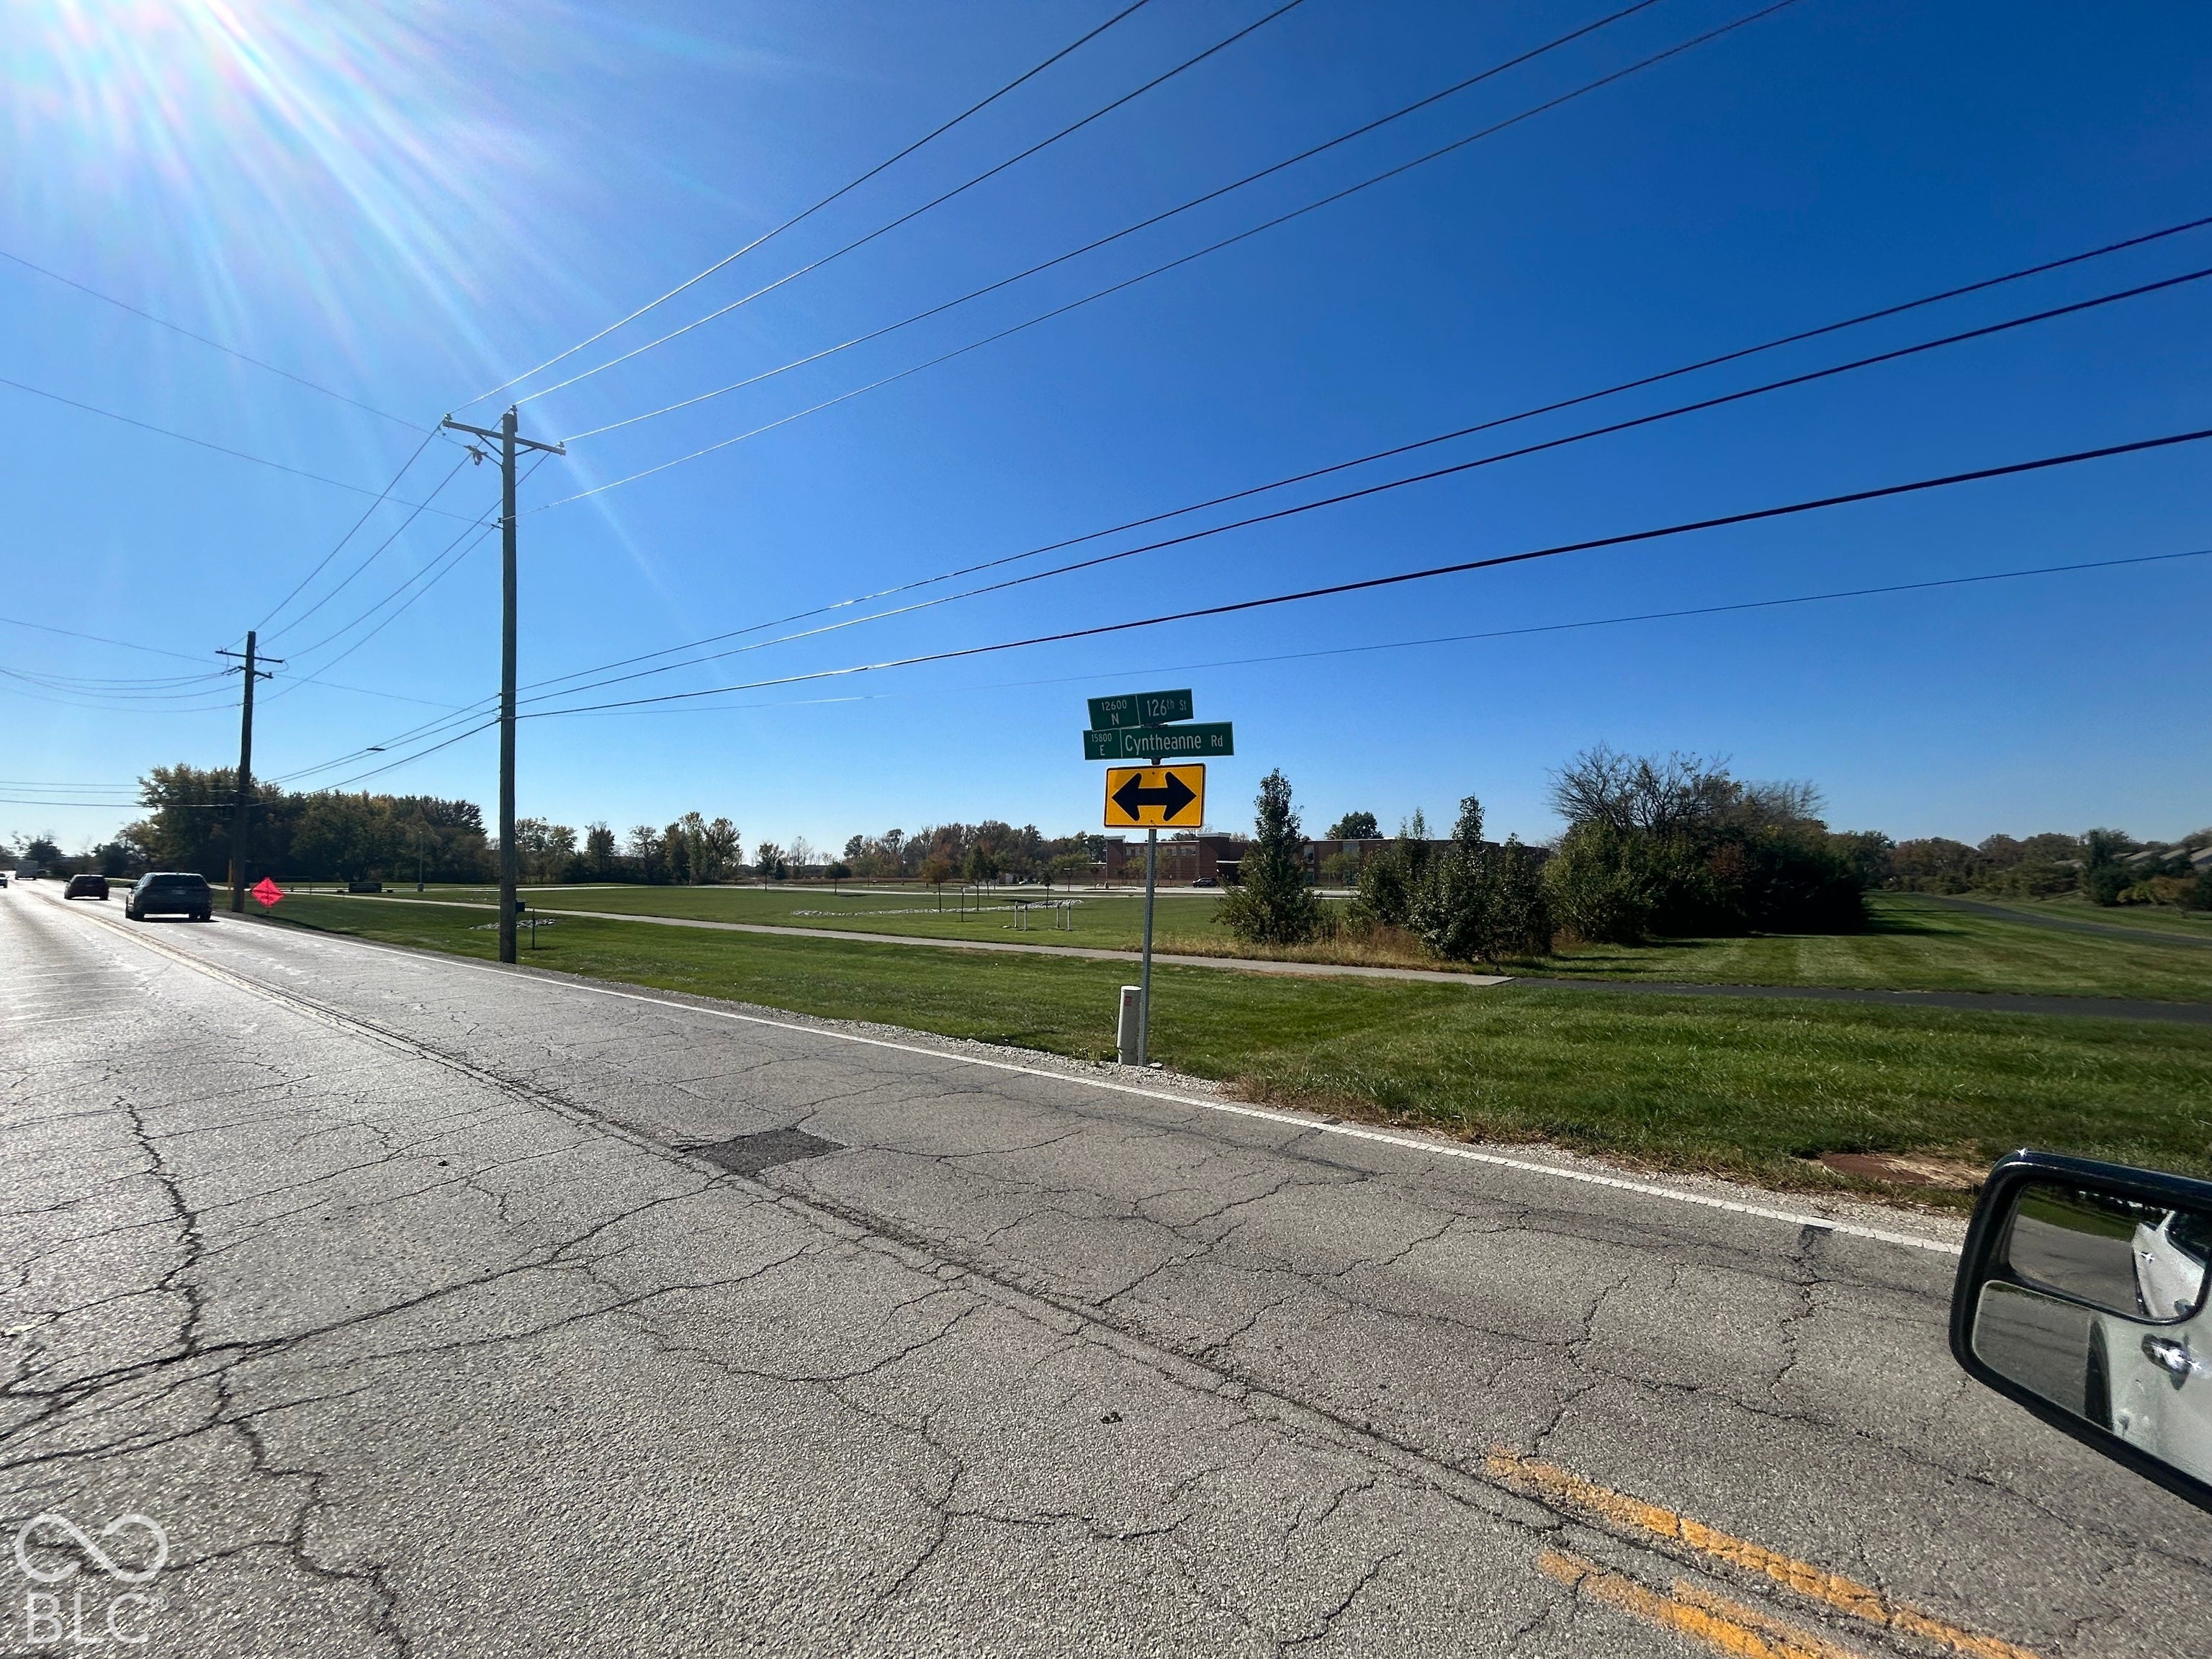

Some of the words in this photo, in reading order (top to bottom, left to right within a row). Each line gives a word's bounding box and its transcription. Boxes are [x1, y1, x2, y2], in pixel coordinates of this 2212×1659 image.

[1102, 699, 1127, 711] 12600
[1146, 698, 1174, 717] 126th
[1179, 699, 1187, 711] St
[1111, 713, 1119, 725] N
[1092, 733, 1112, 742] 15800
[1100, 745, 1106, 755] E
[1125, 734, 1202, 755] Cyntheanne
[1211, 734, 1223, 747] Rd
